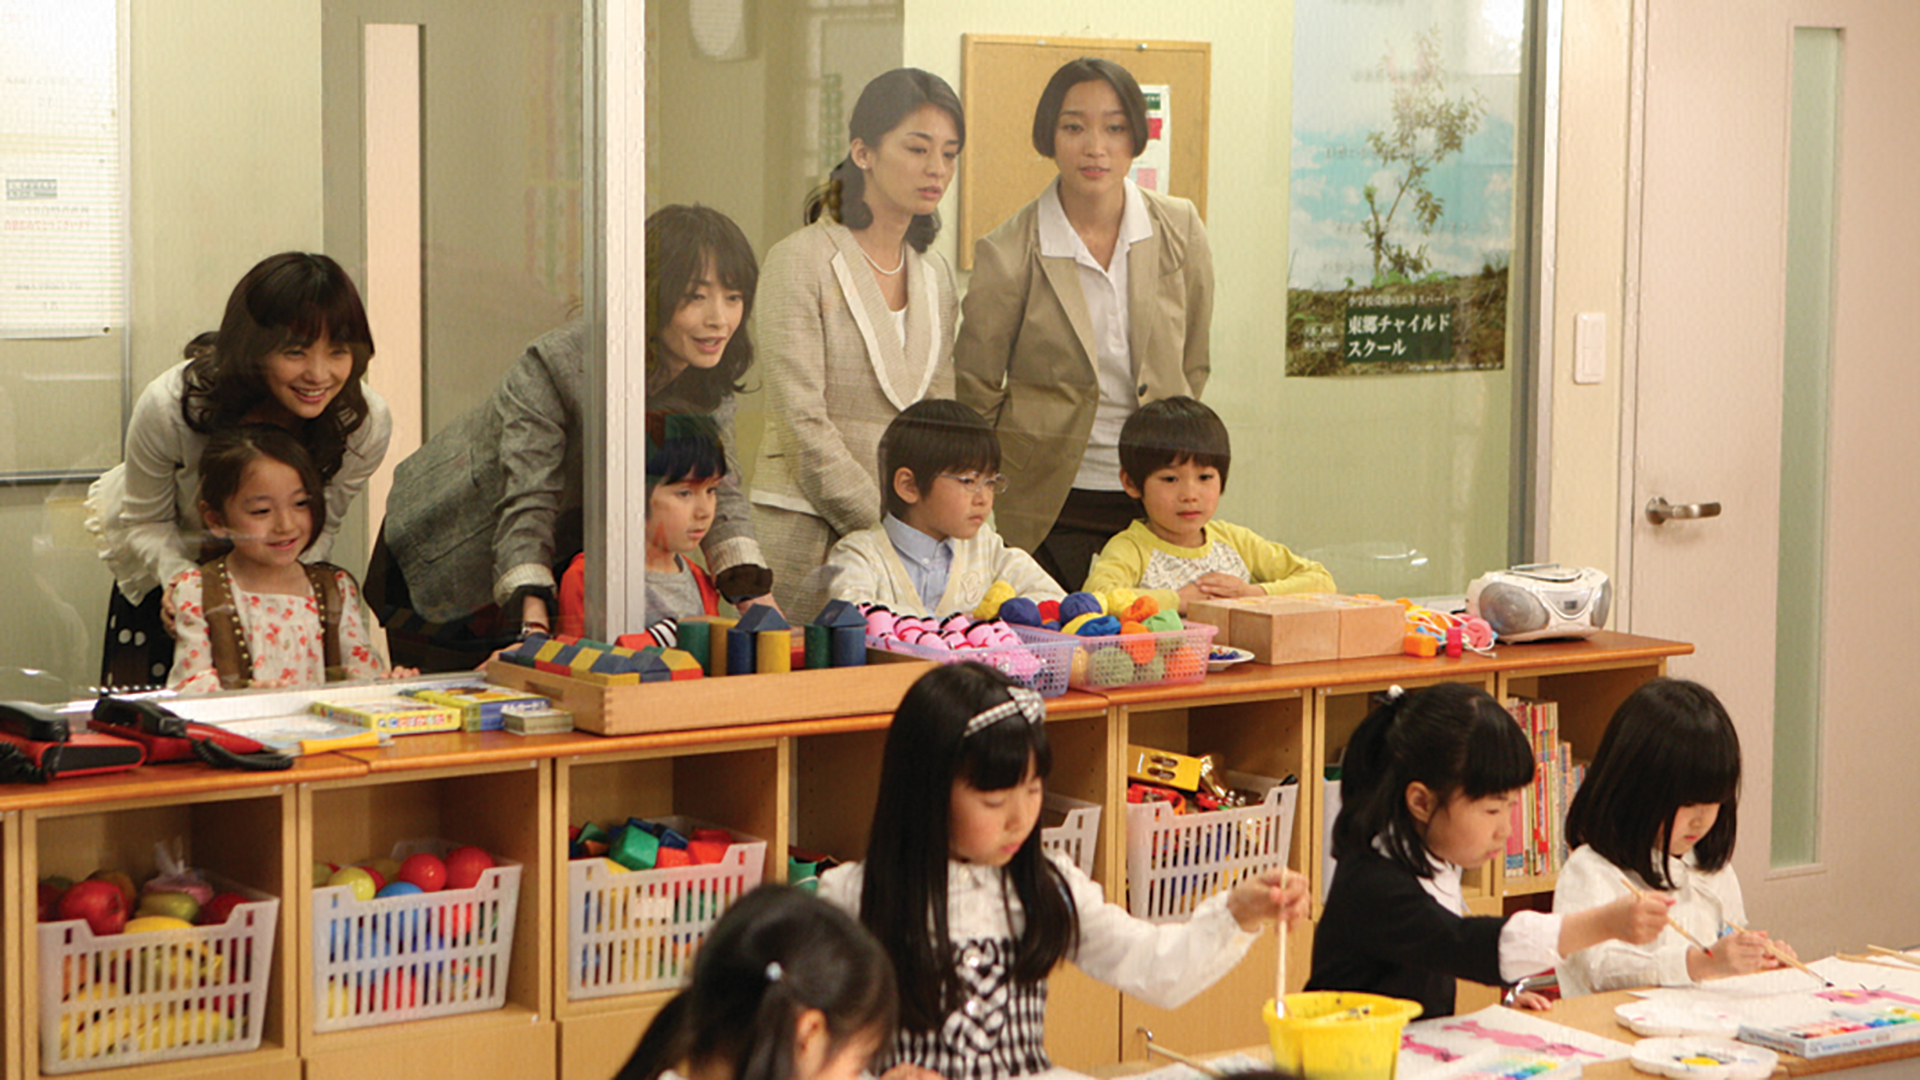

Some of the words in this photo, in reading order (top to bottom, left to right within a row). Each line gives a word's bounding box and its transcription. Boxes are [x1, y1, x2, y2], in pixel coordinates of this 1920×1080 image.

[1347, 313, 1450, 335] 東郷チャイルド
[1347, 338, 1407, 358] スクール
